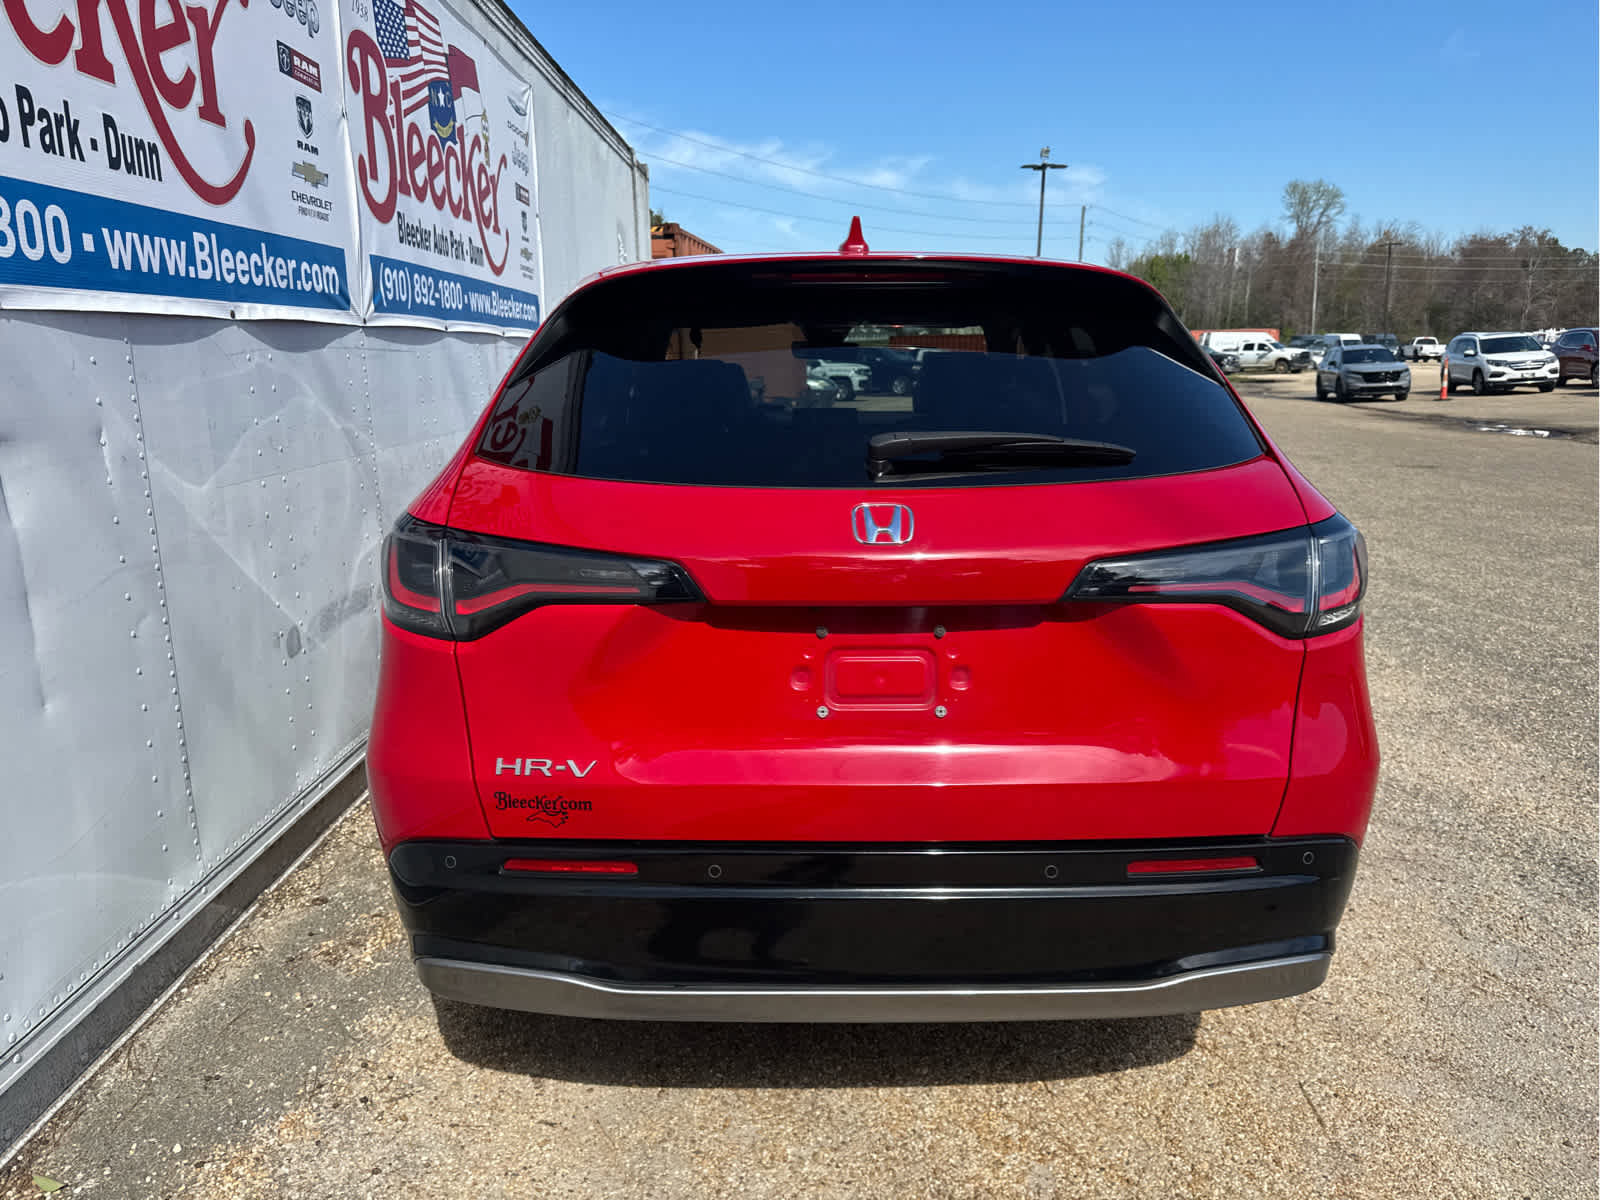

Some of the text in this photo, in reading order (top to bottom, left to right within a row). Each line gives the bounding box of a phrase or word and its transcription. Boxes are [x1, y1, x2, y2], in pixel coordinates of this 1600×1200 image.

[270, 0, 320, 39] eep
[293, 55, 318, 78] RAM
[15, 84, 86, 163] Park
[102, 112, 163, 182] Dunn
[296, 139, 319, 156] RAM
[347, 29, 509, 276] Bleecker
[291, 190, 332, 211] CHEVROLET
[397, 211, 431, 252] Bleecker
[433, 223, 449, 257] Auto
[449, 230, 466, 262] Park
[101, 227, 340, 295] www.Bleecker.com
[379, 262, 538, 323] (910) 892-1800 www.Bleecker.com
[495, 757, 598, 778] HR-V
